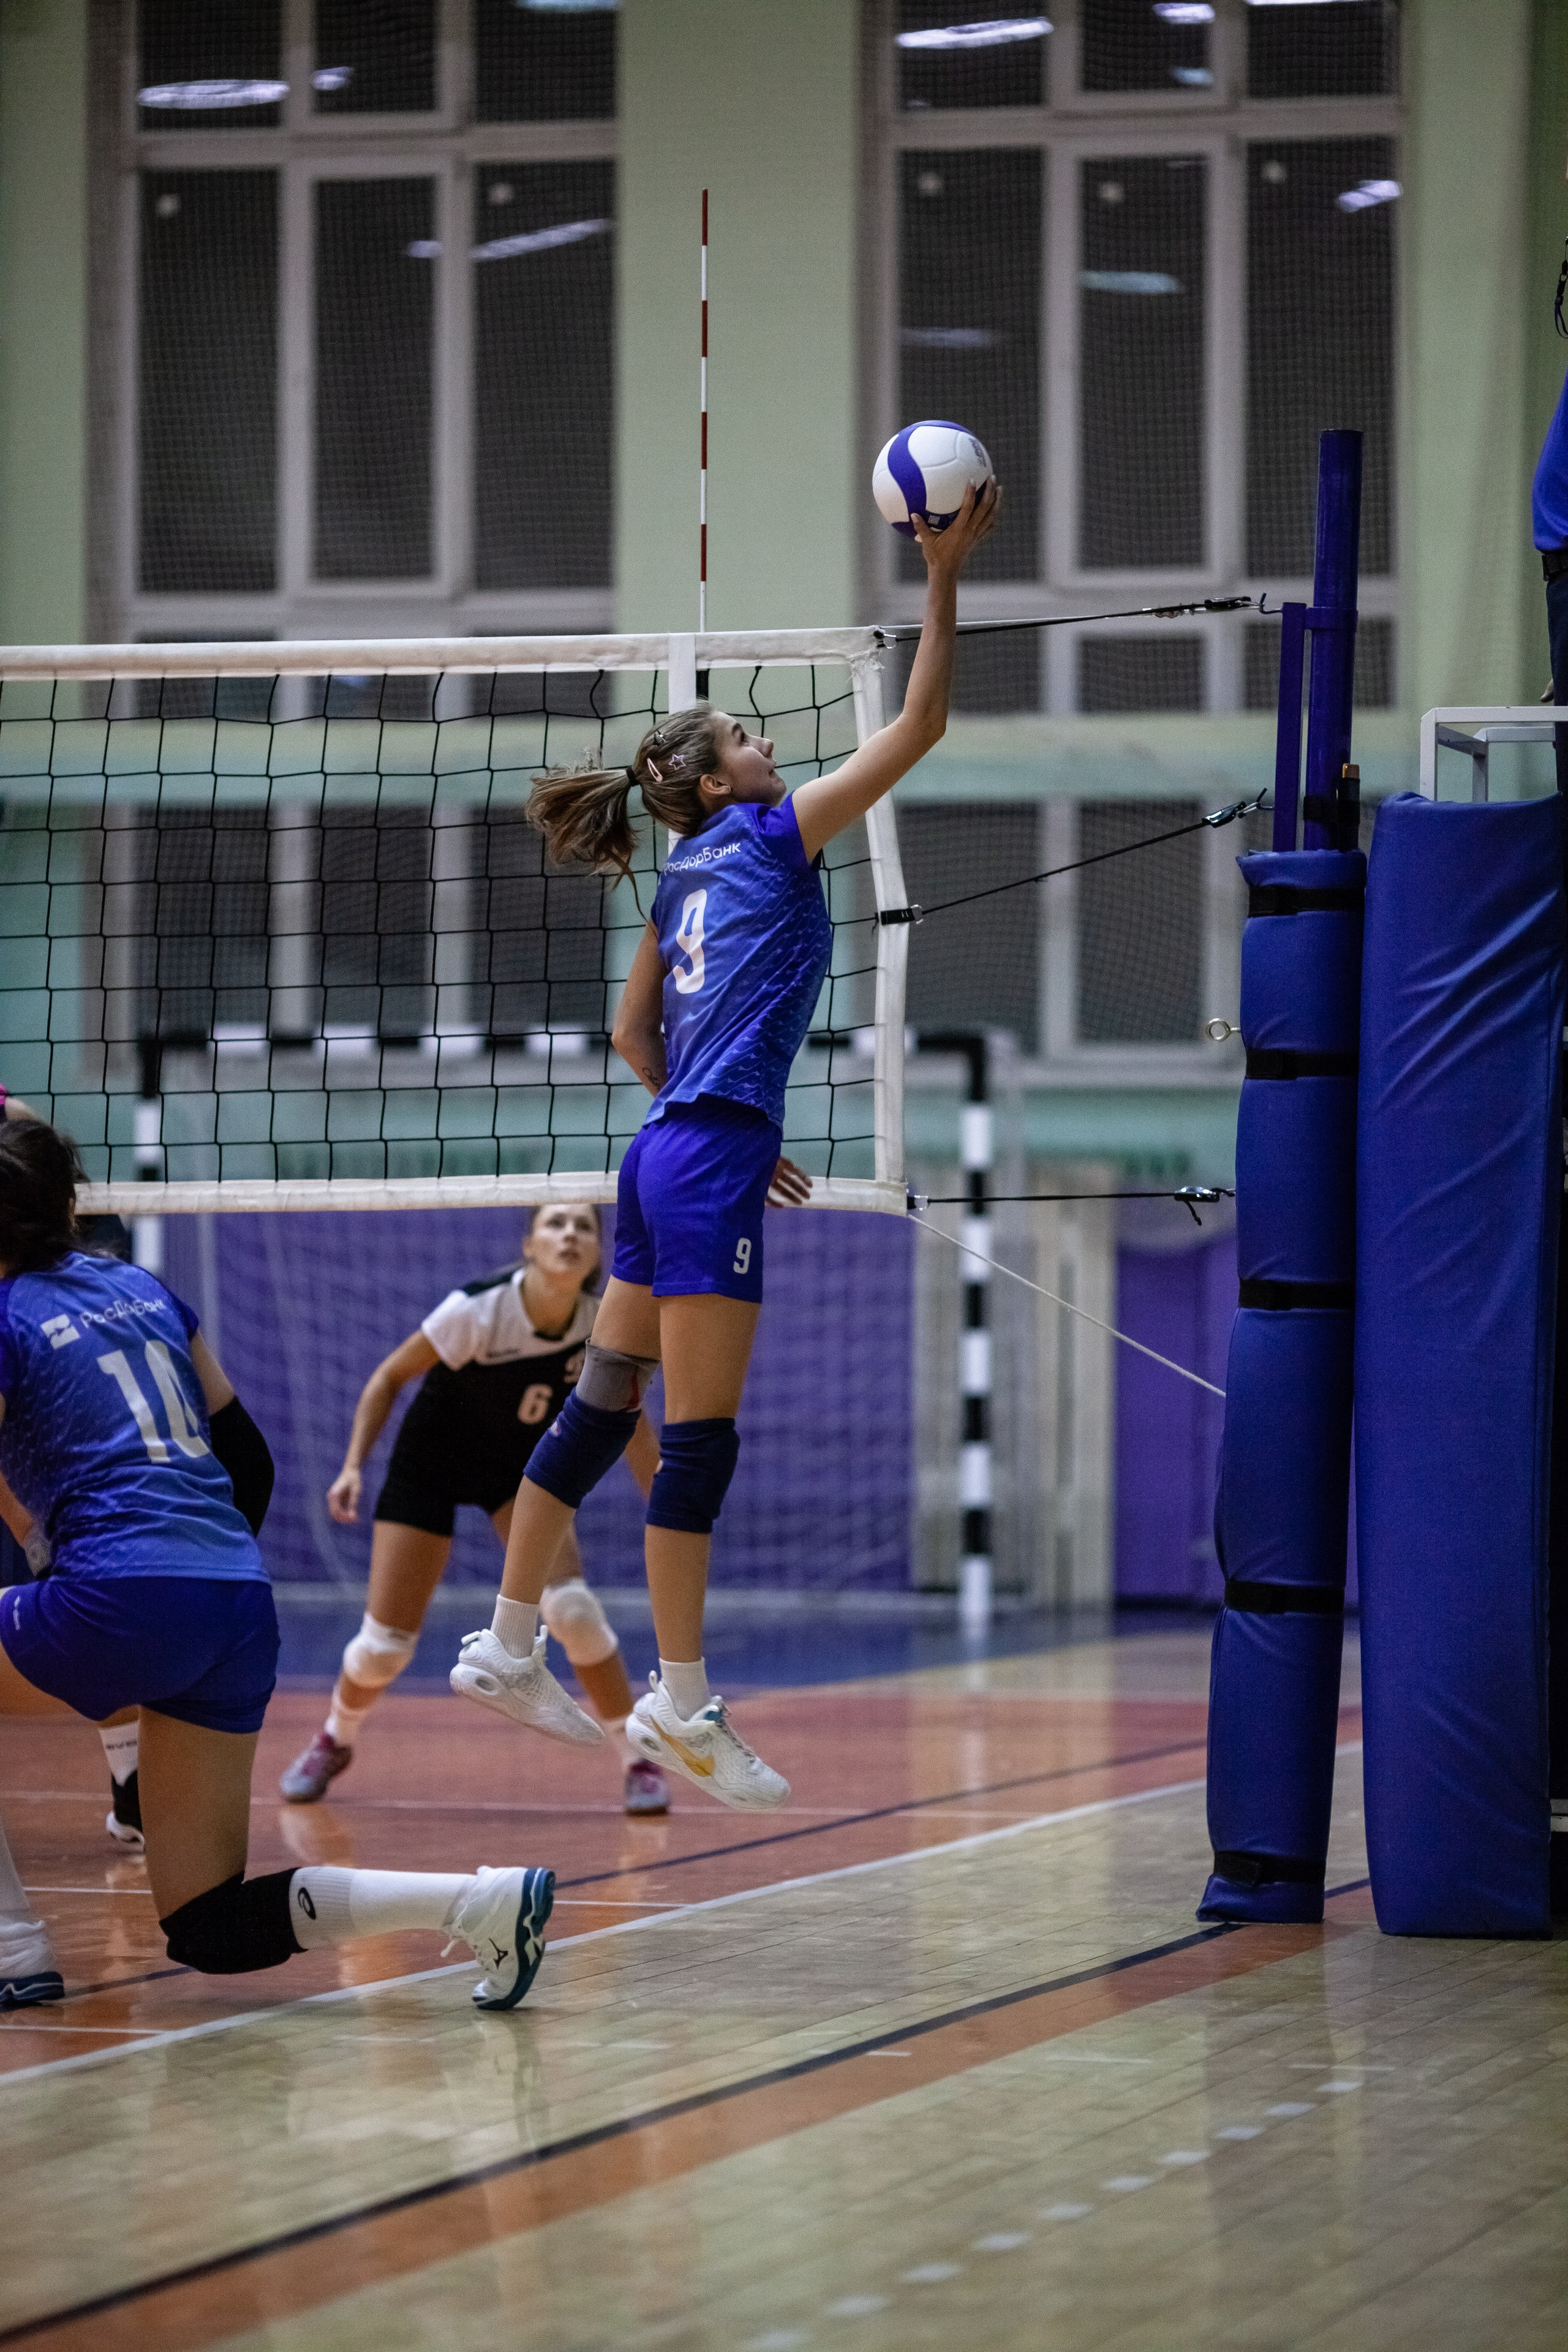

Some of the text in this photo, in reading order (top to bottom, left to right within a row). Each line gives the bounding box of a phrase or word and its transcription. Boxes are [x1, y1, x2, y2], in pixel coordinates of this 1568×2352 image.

[673, 888, 707, 994] 9
[733, 1237, 752, 1275] 9
[97, 1340, 210, 1463] 10
[518, 1383, 554, 1425] 6
